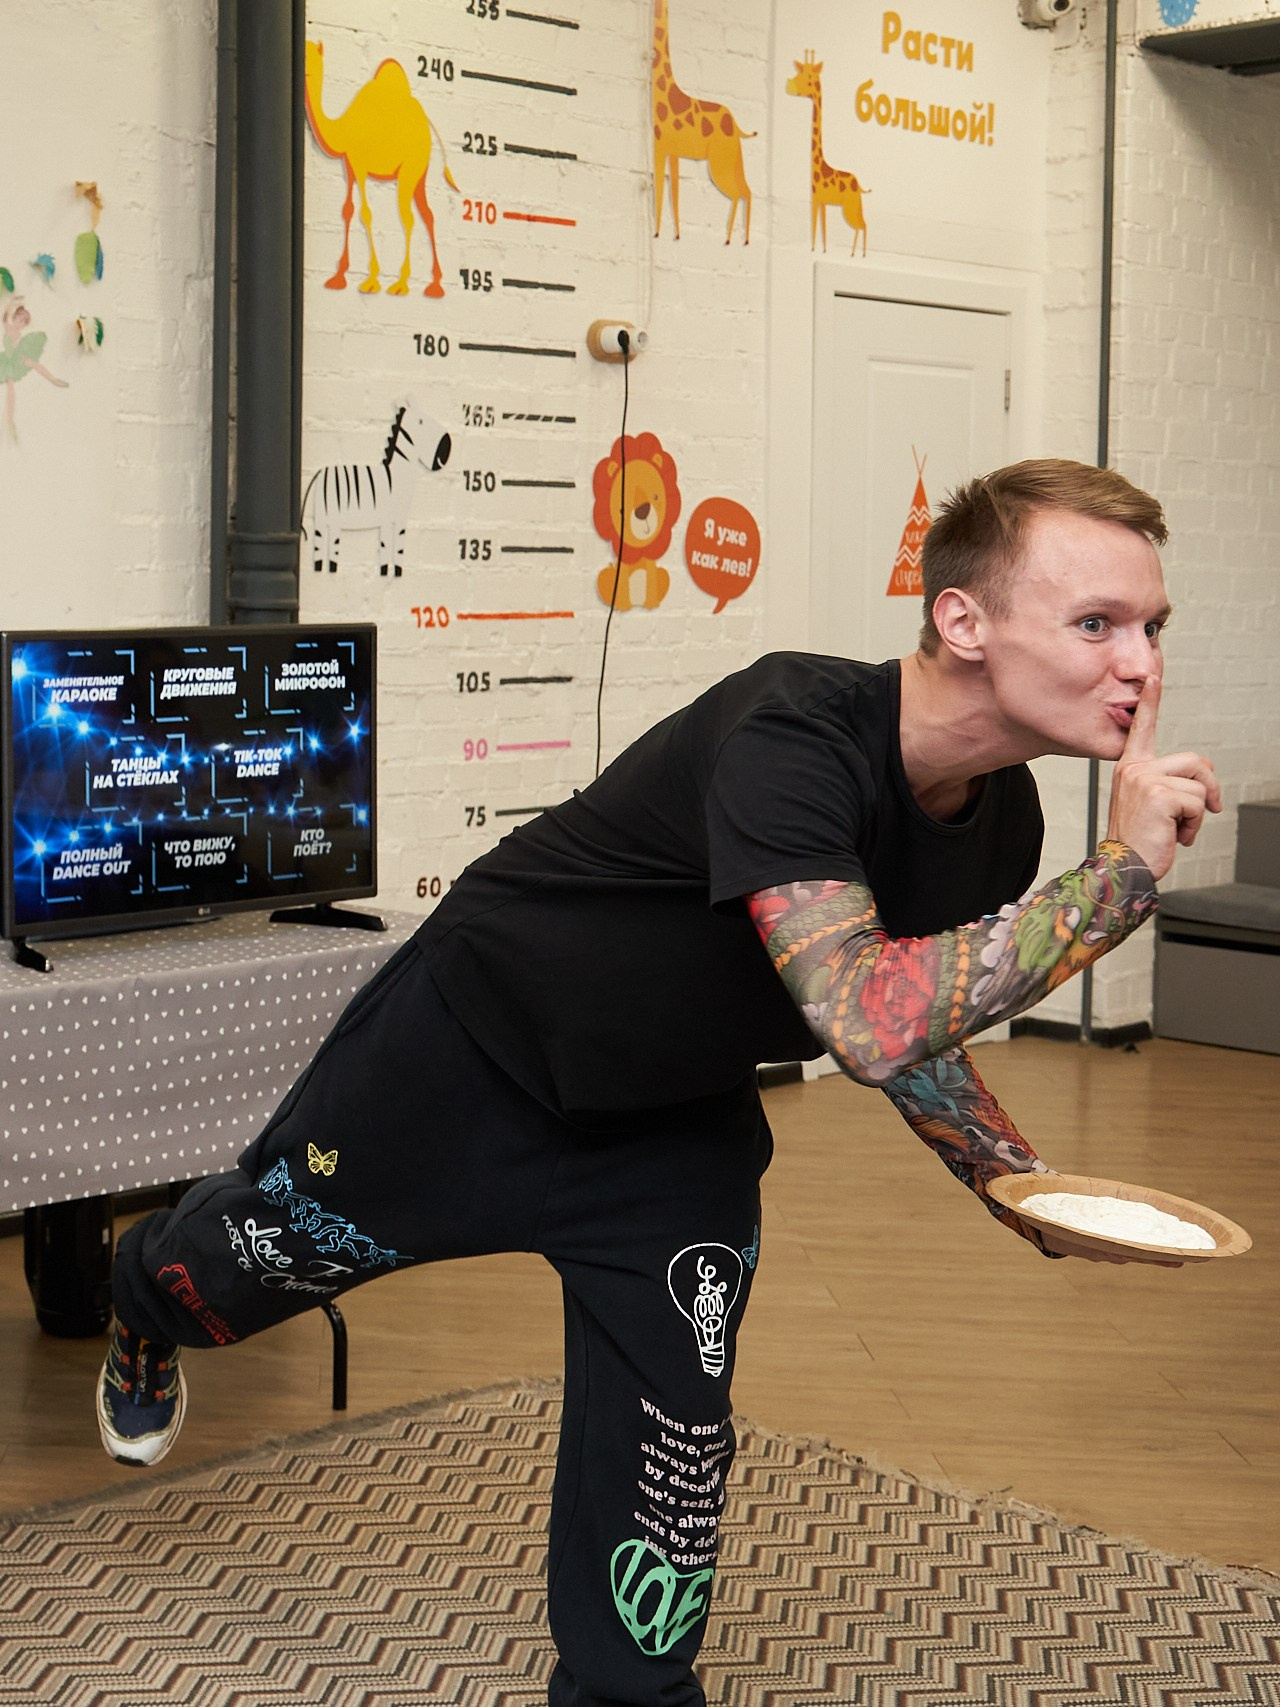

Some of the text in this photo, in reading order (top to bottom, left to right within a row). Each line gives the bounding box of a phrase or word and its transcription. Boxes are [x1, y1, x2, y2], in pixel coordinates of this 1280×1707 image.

[881, 11, 974, 73] Расти
[417, 55, 455, 82] 240
[855, 78, 995, 147] большой!
[462, 131, 498, 157] 225
[462, 199, 497, 225] 210
[460, 268, 494, 293] 195
[413, 334, 450, 358] 180
[462, 469, 496, 493] 150
[704, 518, 747, 547] Я уже
[458, 538, 492, 561] 135
[691, 550, 752, 578] как лев!
[410, 605, 450, 629] 120
[163, 667, 235, 682] КРУГОВЫЕ
[281, 659, 340, 676] ЗОЛОТОЙ
[43, 675, 125, 688] ЗАМЕНЯТЕЛЬНОЕ
[160, 681, 237, 700] ДВИЖЕНИЯ
[274, 676, 346, 691] МИКРОФОН
[456, 671, 491, 694] 105
[51, 688, 118, 703] КАРАОКЕ
[463, 739, 488, 760] 90
[111, 756, 162, 773] ТАНЦЫ
[236, 763, 280, 778] DANCE
[93, 769, 179, 789] НА СТЁКЛАХ
[465, 805, 487, 827] 75
[164, 836, 236, 854] ЧТО ВИЖУ,
[300, 828, 325, 842] КТО
[60, 842, 123, 864] ПОЛНЫЙ
[174, 851, 227, 868] ТО ПОЮ
[293, 841, 332, 858] ПОЁТ?
[52, 860, 131, 880] DANCE OUT
[416, 876, 441, 898] 60
[640, 1397, 719, 1436] When one
[660, 1431, 701, 1458] love,
[640, 1442, 698, 1475] always
[644, 1460, 666, 1481] by
[637, 1480, 715, 1510] one's self,
[648, 1503, 674, 1525] one
[633, 1511, 667, 1537] ends
[669, 1530, 691, 1549] by
